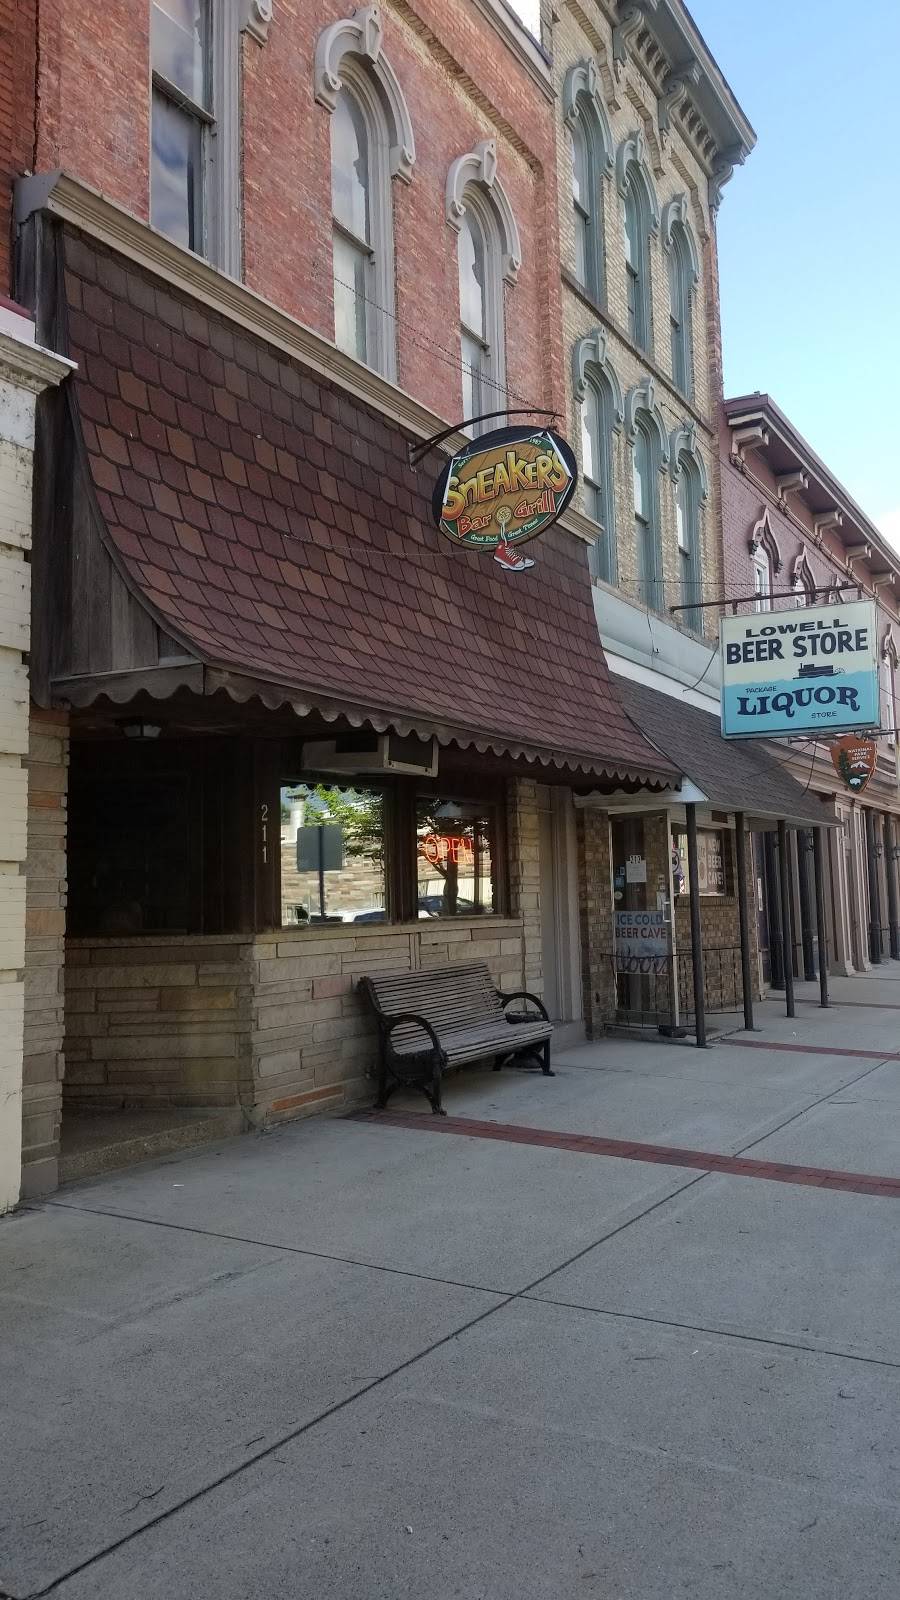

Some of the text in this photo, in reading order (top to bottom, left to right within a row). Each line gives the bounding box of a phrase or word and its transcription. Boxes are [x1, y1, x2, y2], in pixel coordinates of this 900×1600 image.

[457, 514, 492, 538] Bar
[513, 490, 557, 518] Grill
[745, 618, 849, 639] LOWELL
[726, 628, 869, 665] BEER STORE
[745, 685, 777, 694] PACKAGE
[736, 686, 861, 718] LIQUOR
[811, 710, 838, 719] STORE
[425, 834, 473, 863] OPEN
[617, 914, 663, 926] ICE COLD
[615, 927, 667, 938] BEER CAVE
